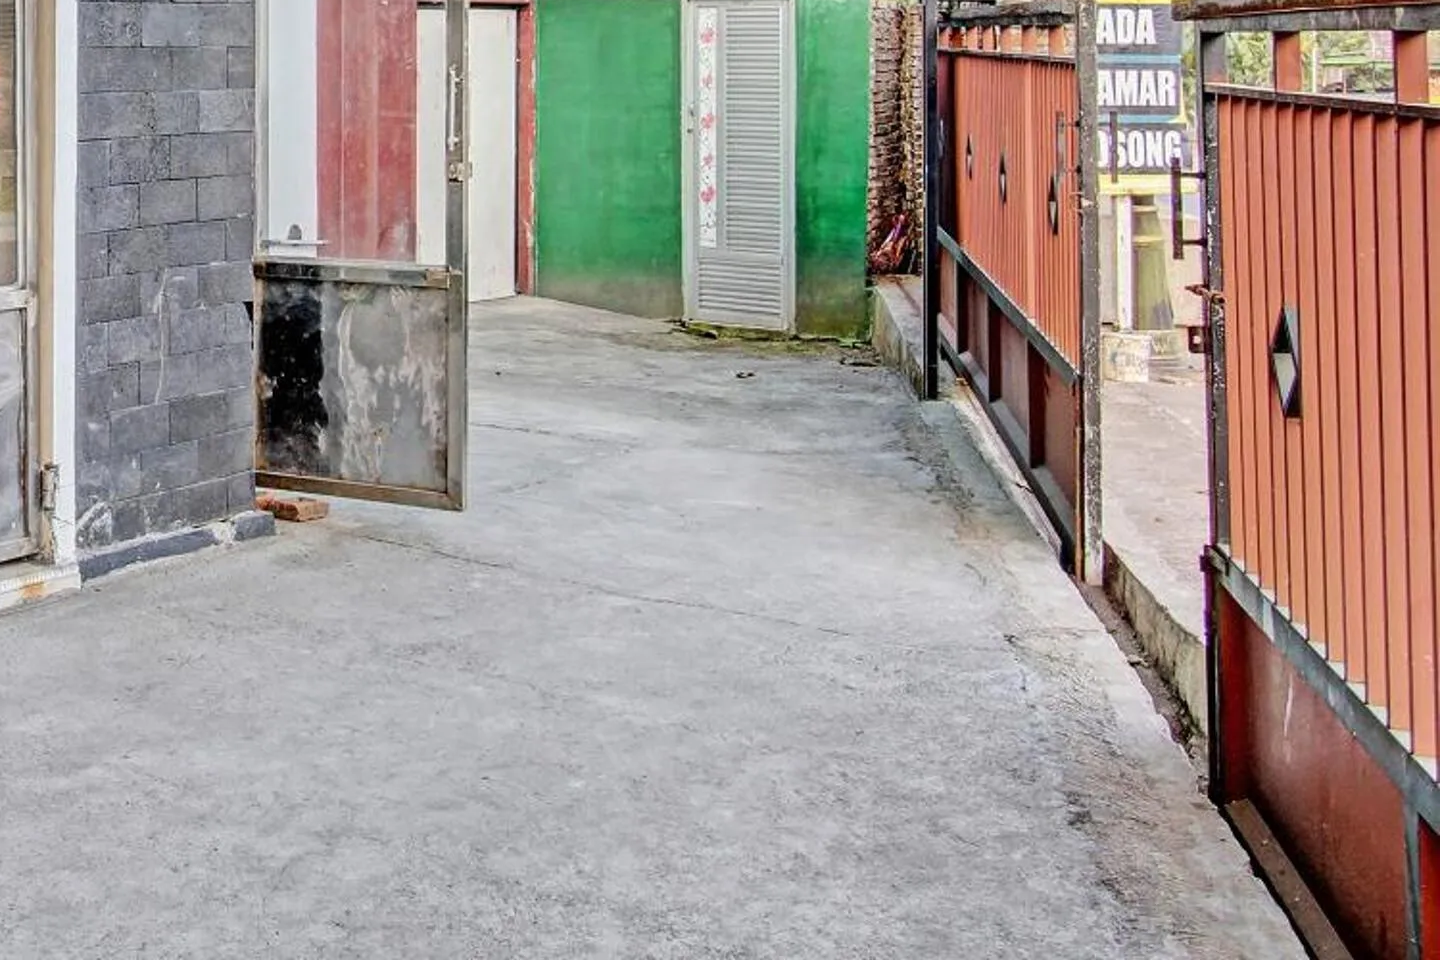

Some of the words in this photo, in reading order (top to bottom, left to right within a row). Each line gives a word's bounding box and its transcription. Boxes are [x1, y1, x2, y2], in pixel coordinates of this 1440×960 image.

[1096, 7, 1157, 45] ADA
[1098, 69, 1176, 106] AMAR
[1098, 129, 1182, 169] OSONG
